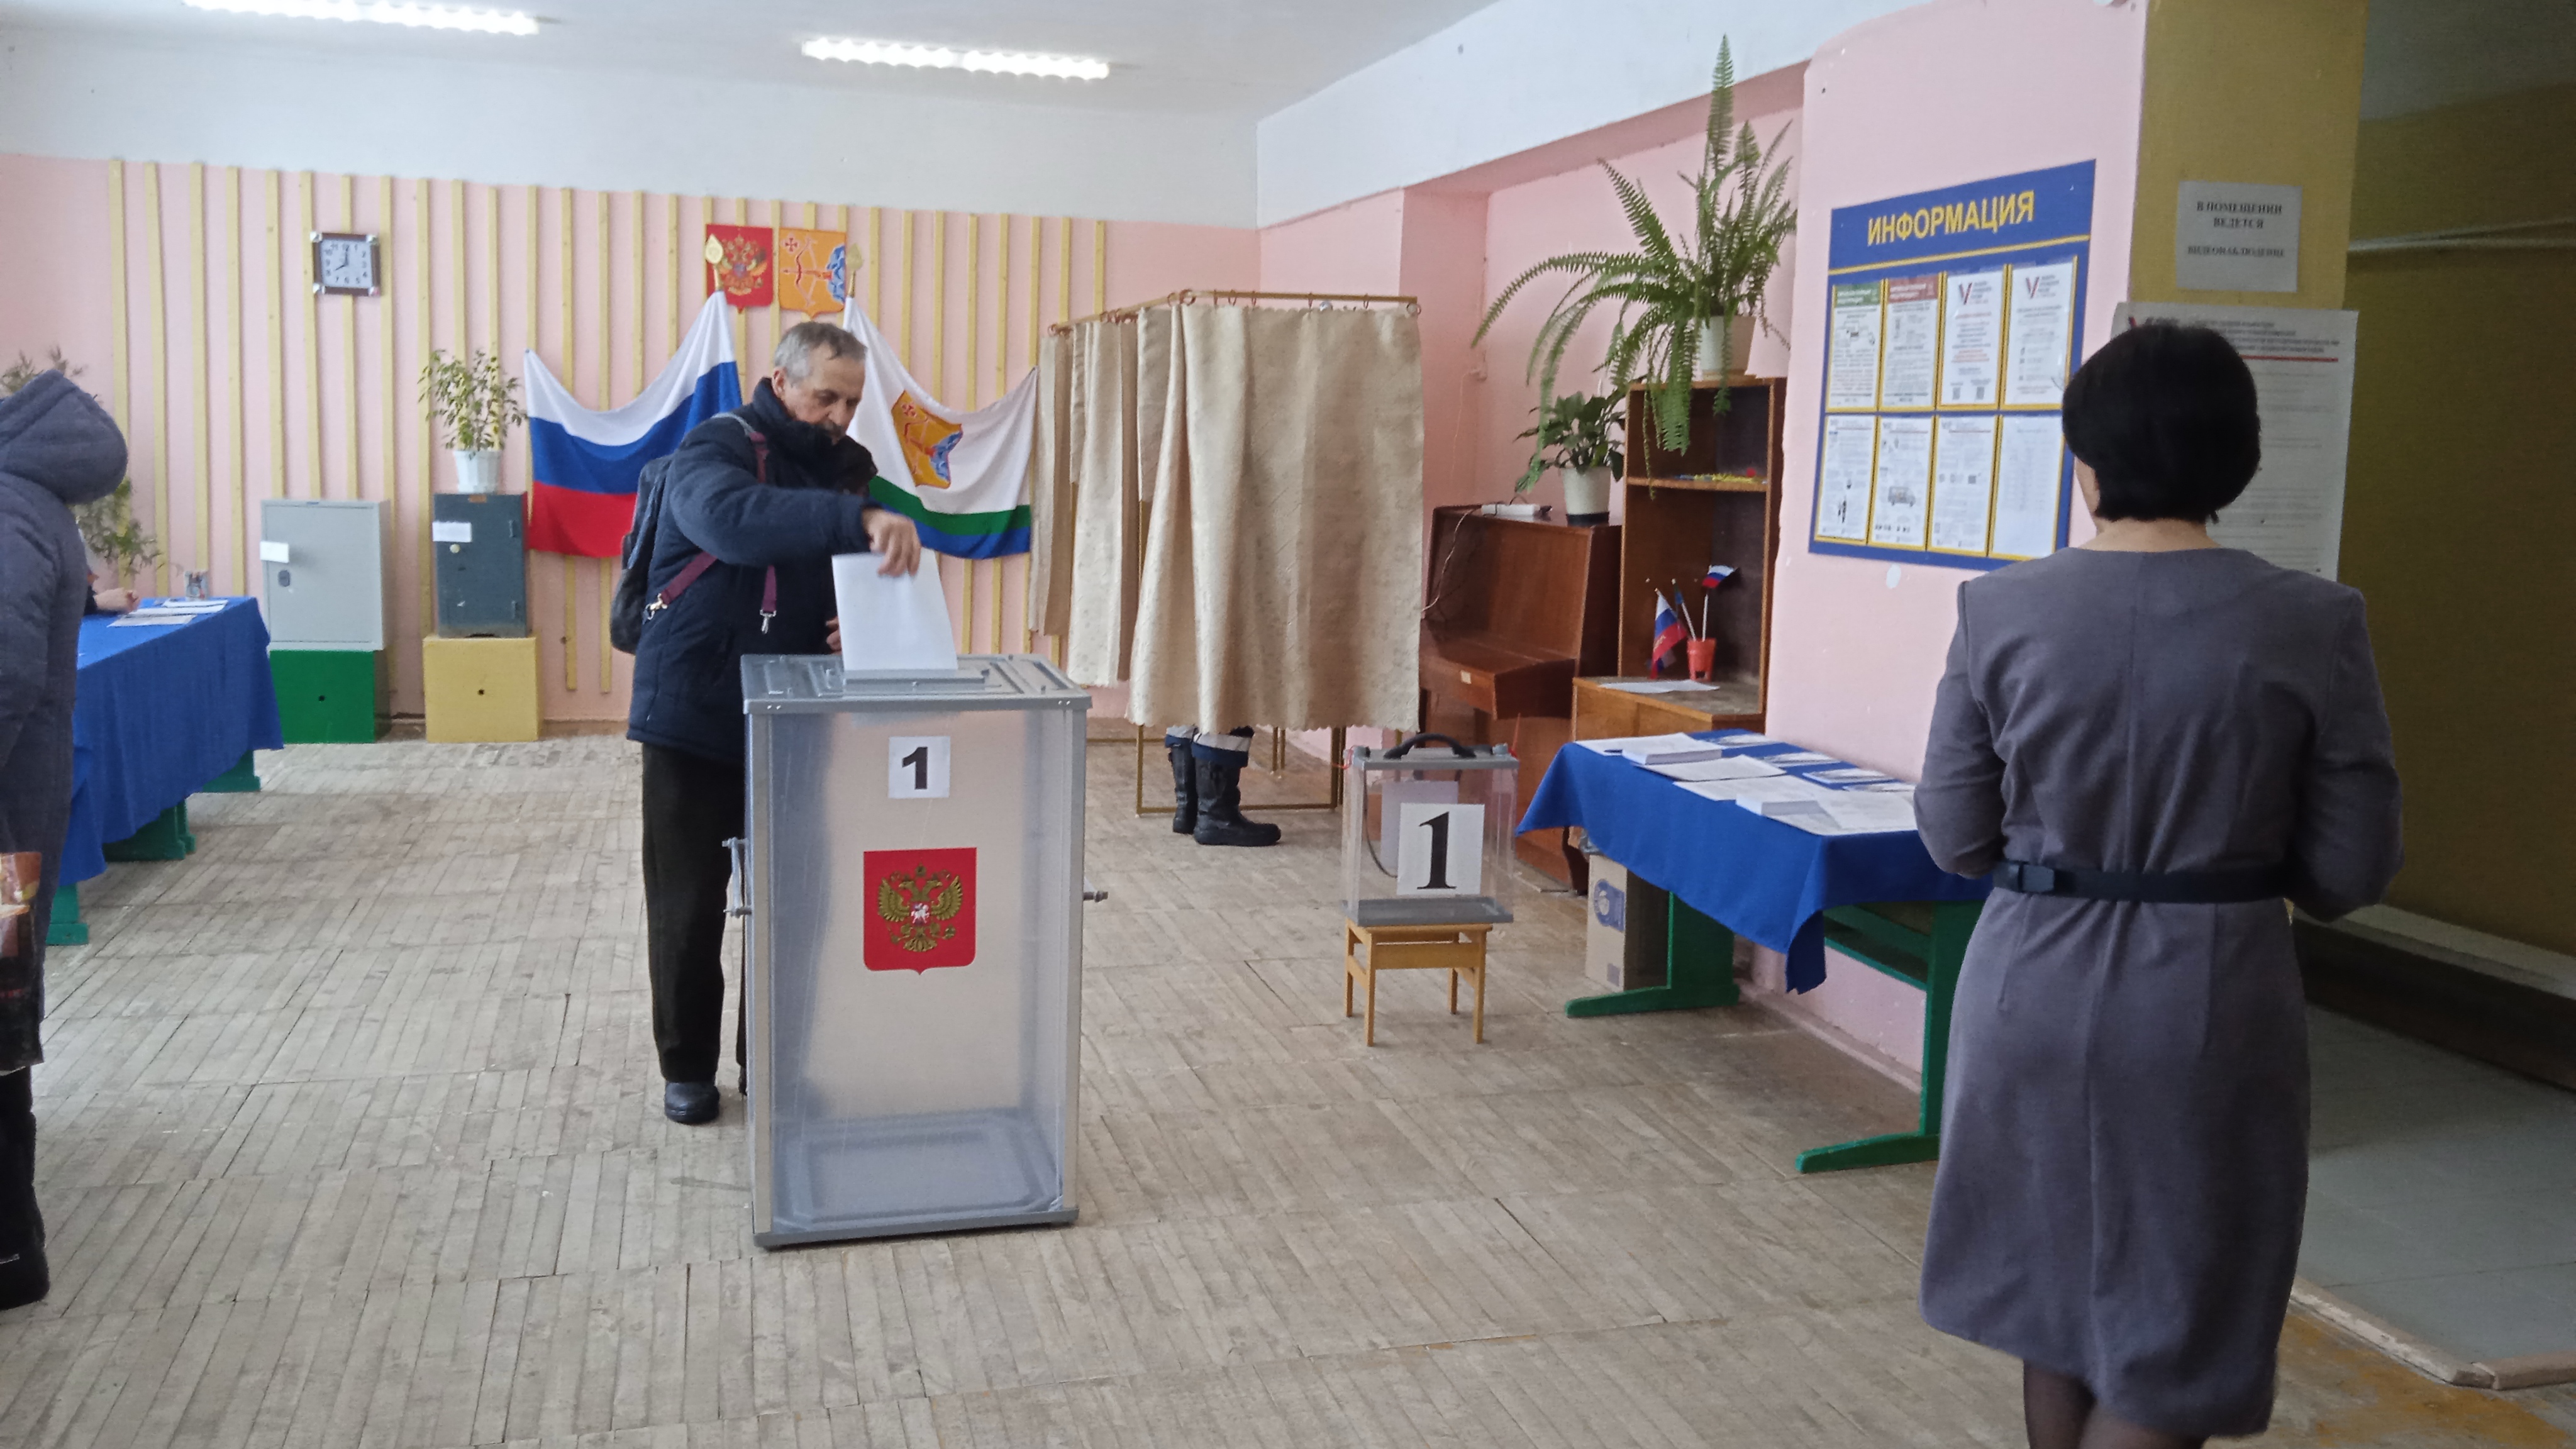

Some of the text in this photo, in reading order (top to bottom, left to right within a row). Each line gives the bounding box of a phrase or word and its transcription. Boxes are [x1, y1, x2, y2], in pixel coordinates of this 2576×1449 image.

[1867, 190, 2035, 247] ИНФОРМАЦИЯ
[902, 747, 928, 790] 1
[1417, 811, 1457, 890] 1
